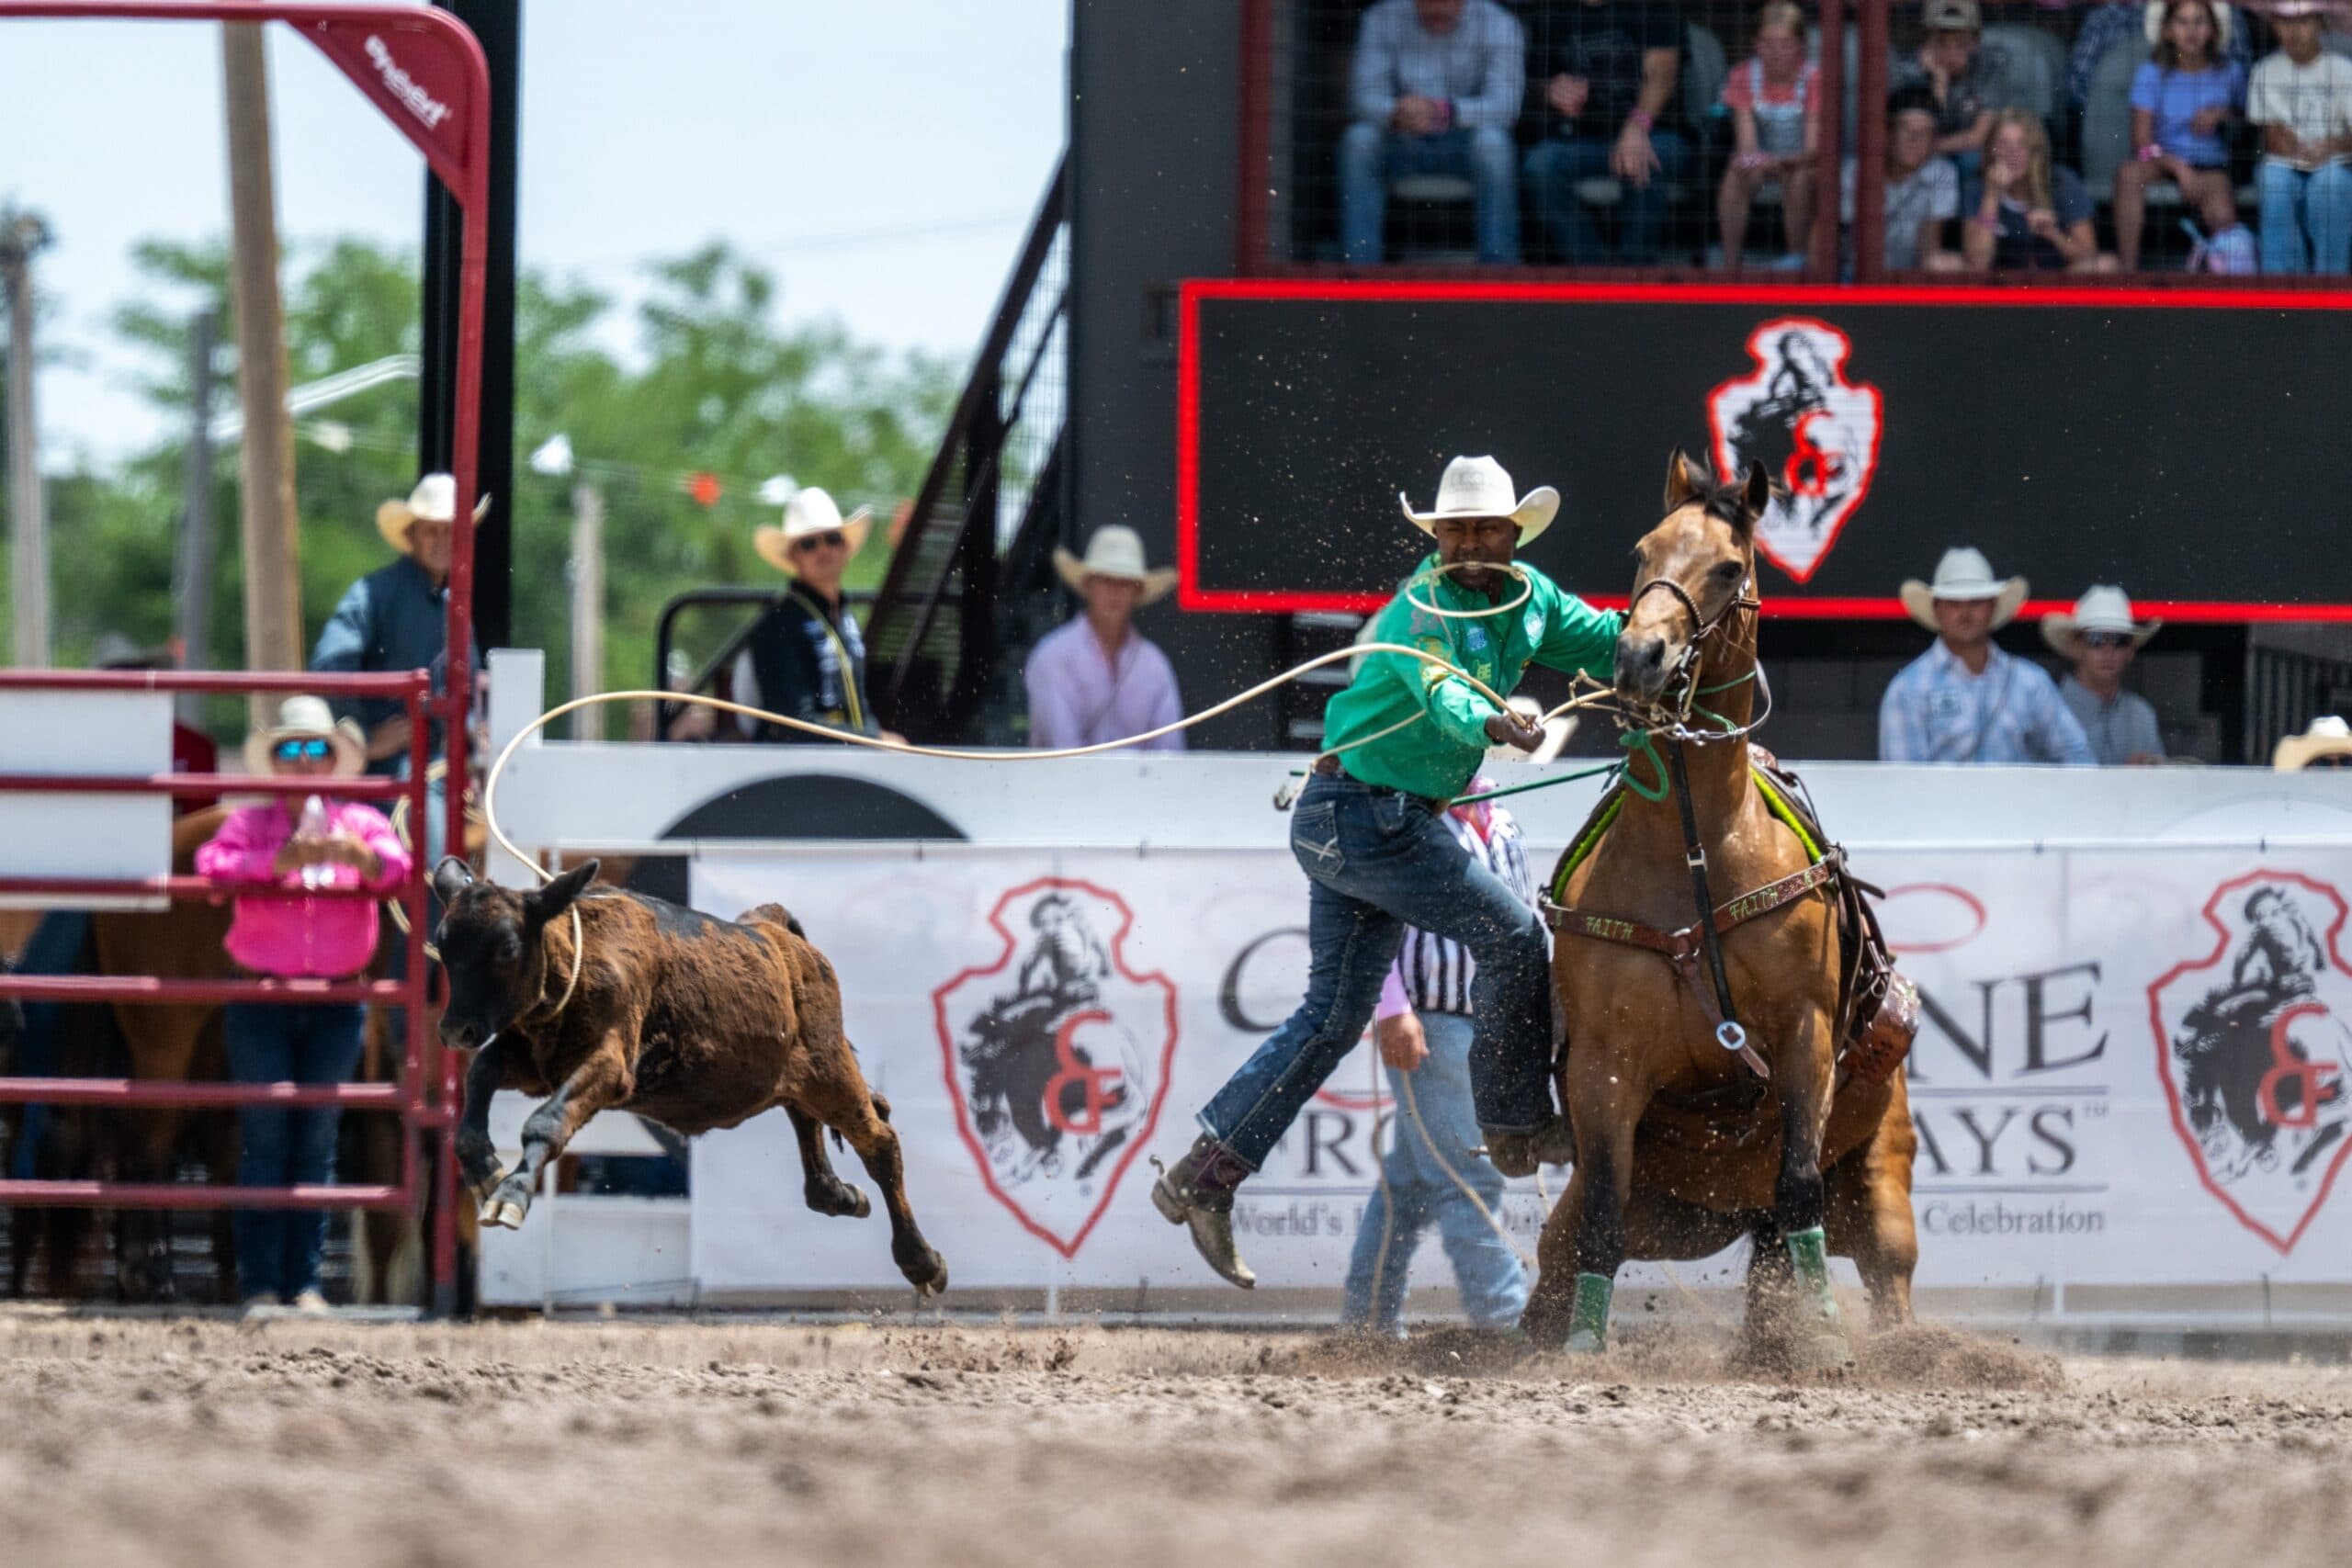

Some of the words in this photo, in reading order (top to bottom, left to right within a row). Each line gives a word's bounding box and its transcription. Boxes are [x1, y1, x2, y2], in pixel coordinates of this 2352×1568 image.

[1729, 888, 1779, 920] FAITH
[1587, 916, 1634, 940] FAITH
[1912, 1104, 2075, 1176] AYS
[1923, 1201, 2106, 1235] Celebration
